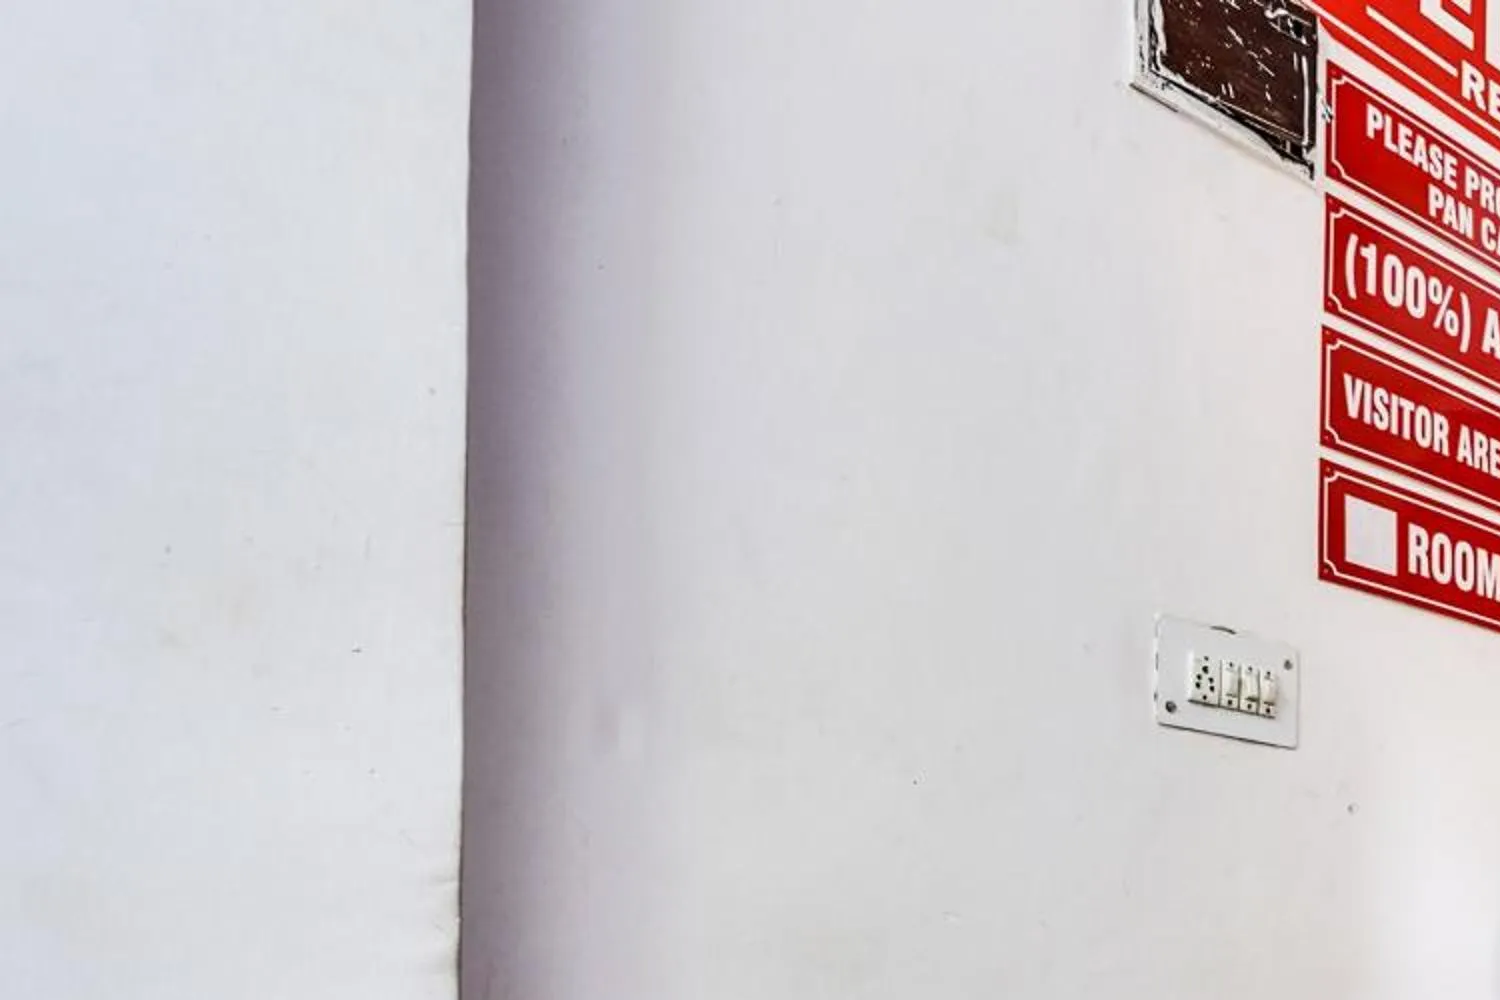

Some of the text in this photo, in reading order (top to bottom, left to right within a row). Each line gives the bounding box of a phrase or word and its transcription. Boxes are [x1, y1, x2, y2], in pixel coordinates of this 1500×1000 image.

[1366, 102, 1458, 190] PLEASE
[1428, 183, 1474, 240] PAN
[1345, 233, 1471, 353] (100%)
[1343, 372, 1450, 457] VISITOR
